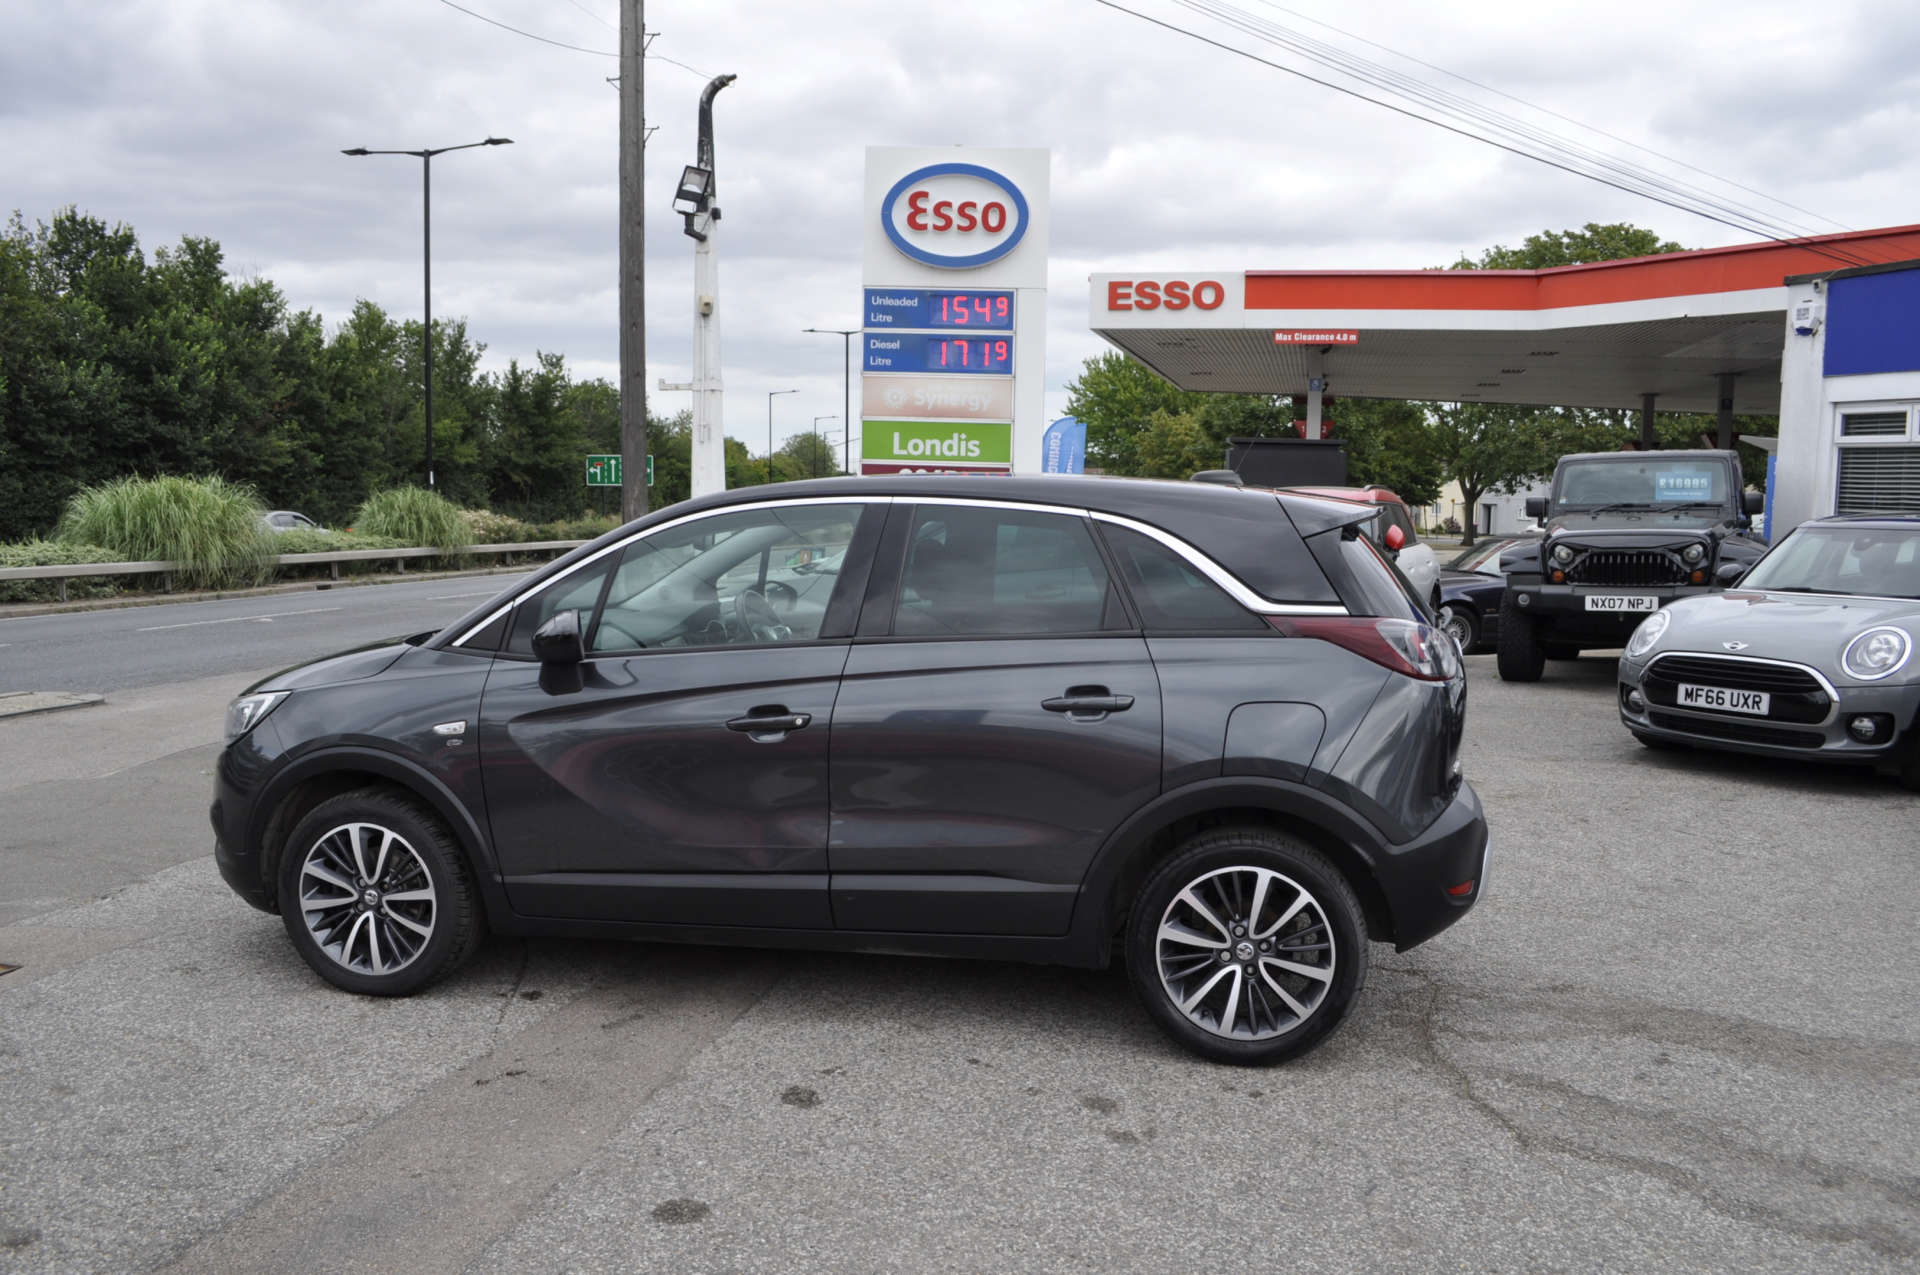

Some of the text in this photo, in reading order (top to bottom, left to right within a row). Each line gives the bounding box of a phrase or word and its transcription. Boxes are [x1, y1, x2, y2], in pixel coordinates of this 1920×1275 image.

[1108, 280, 1225, 311] ESSO
[871, 296, 918, 307] Unleaded
[870, 312, 893, 323] Litre
[1275, 332, 1292, 341] Max
[1294, 332, 1335, 341] Clearance
[870, 339, 900, 350] Diesel
[870, 356, 892, 366] Litre
[913, 387, 992, 412] Synergy
[893, 432, 981, 457] Londis
[1591, 599, 1653, 610] NX07 NPJ
[1684, 687, 1762, 710] MF66 UXR
